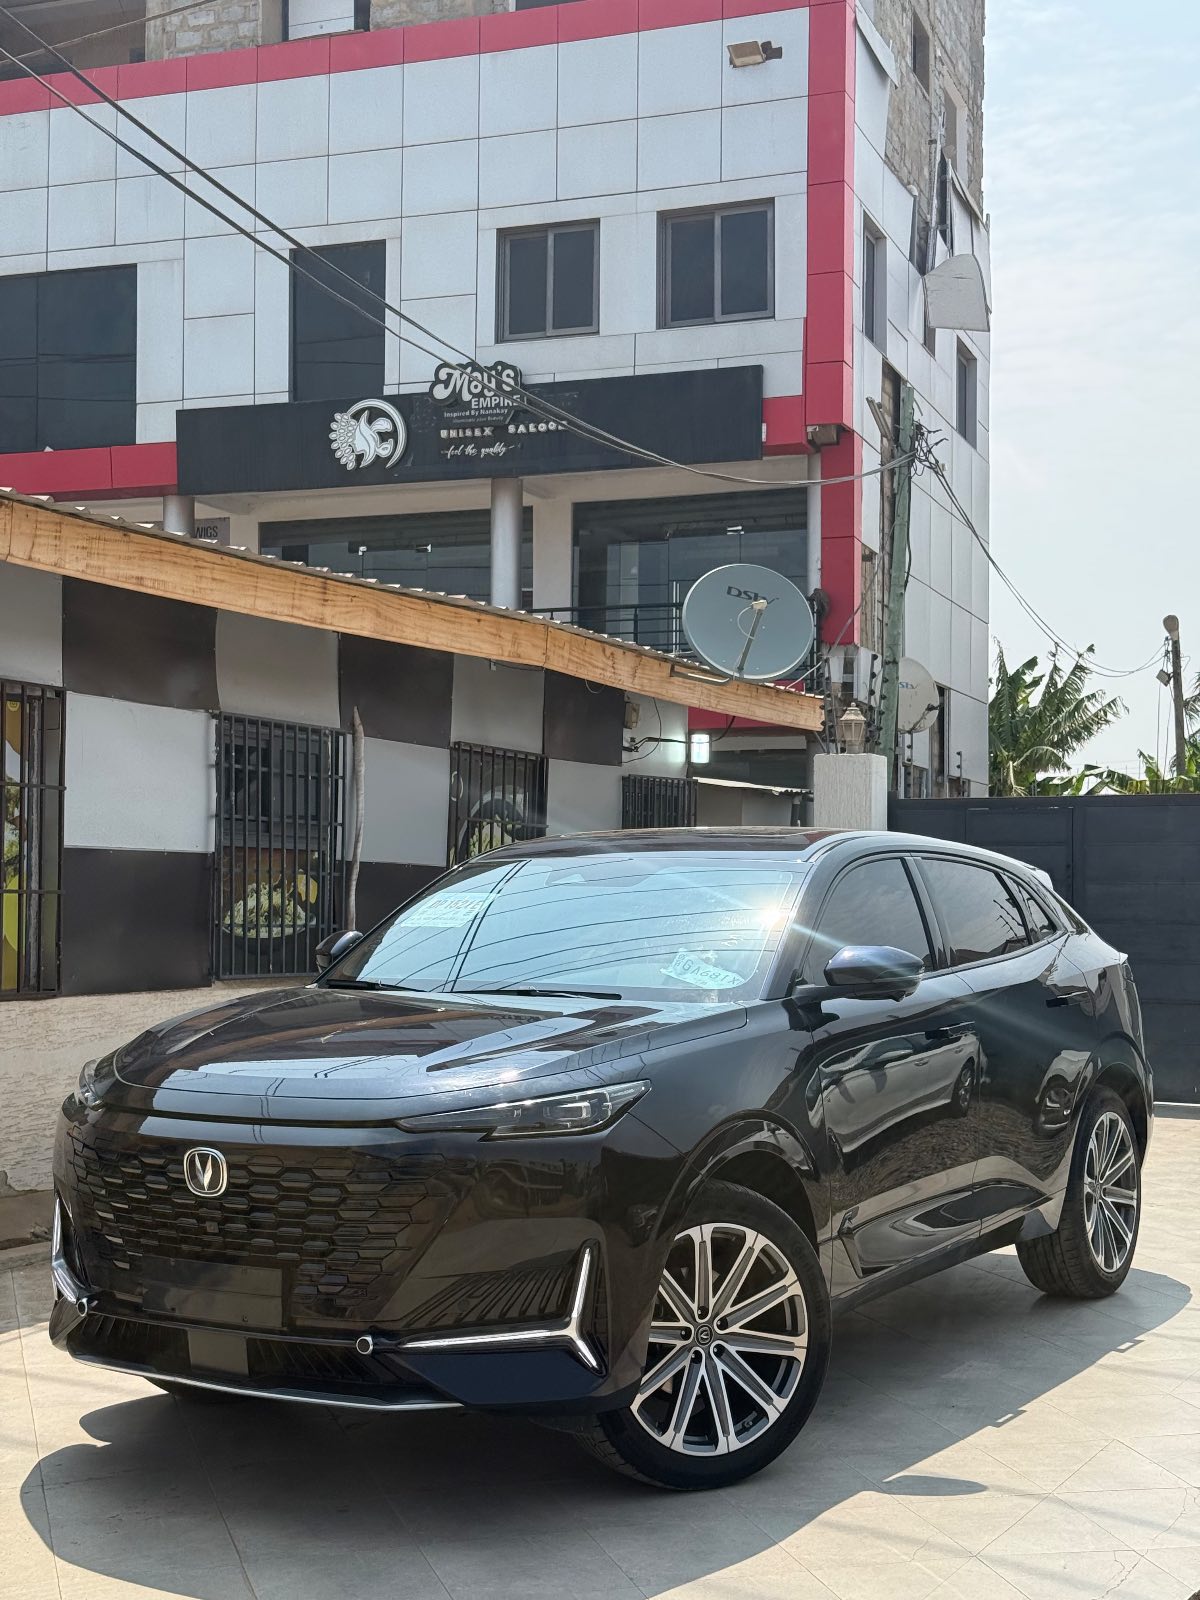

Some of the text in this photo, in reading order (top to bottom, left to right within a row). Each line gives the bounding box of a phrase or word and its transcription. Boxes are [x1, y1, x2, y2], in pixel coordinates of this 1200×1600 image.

[433, 365, 515, 402] Moy's
[471, 395, 521, 409] EMPIRE
[444, 410, 469, 418] Inspired
[471, 408, 479, 416] By
[440, 427, 494, 439] UNISEX
[465, 443, 477, 456] the
[480, 442, 506, 458] quality
[192, 525, 218, 538] WIGS
[899, 681, 919, 690] Stv
